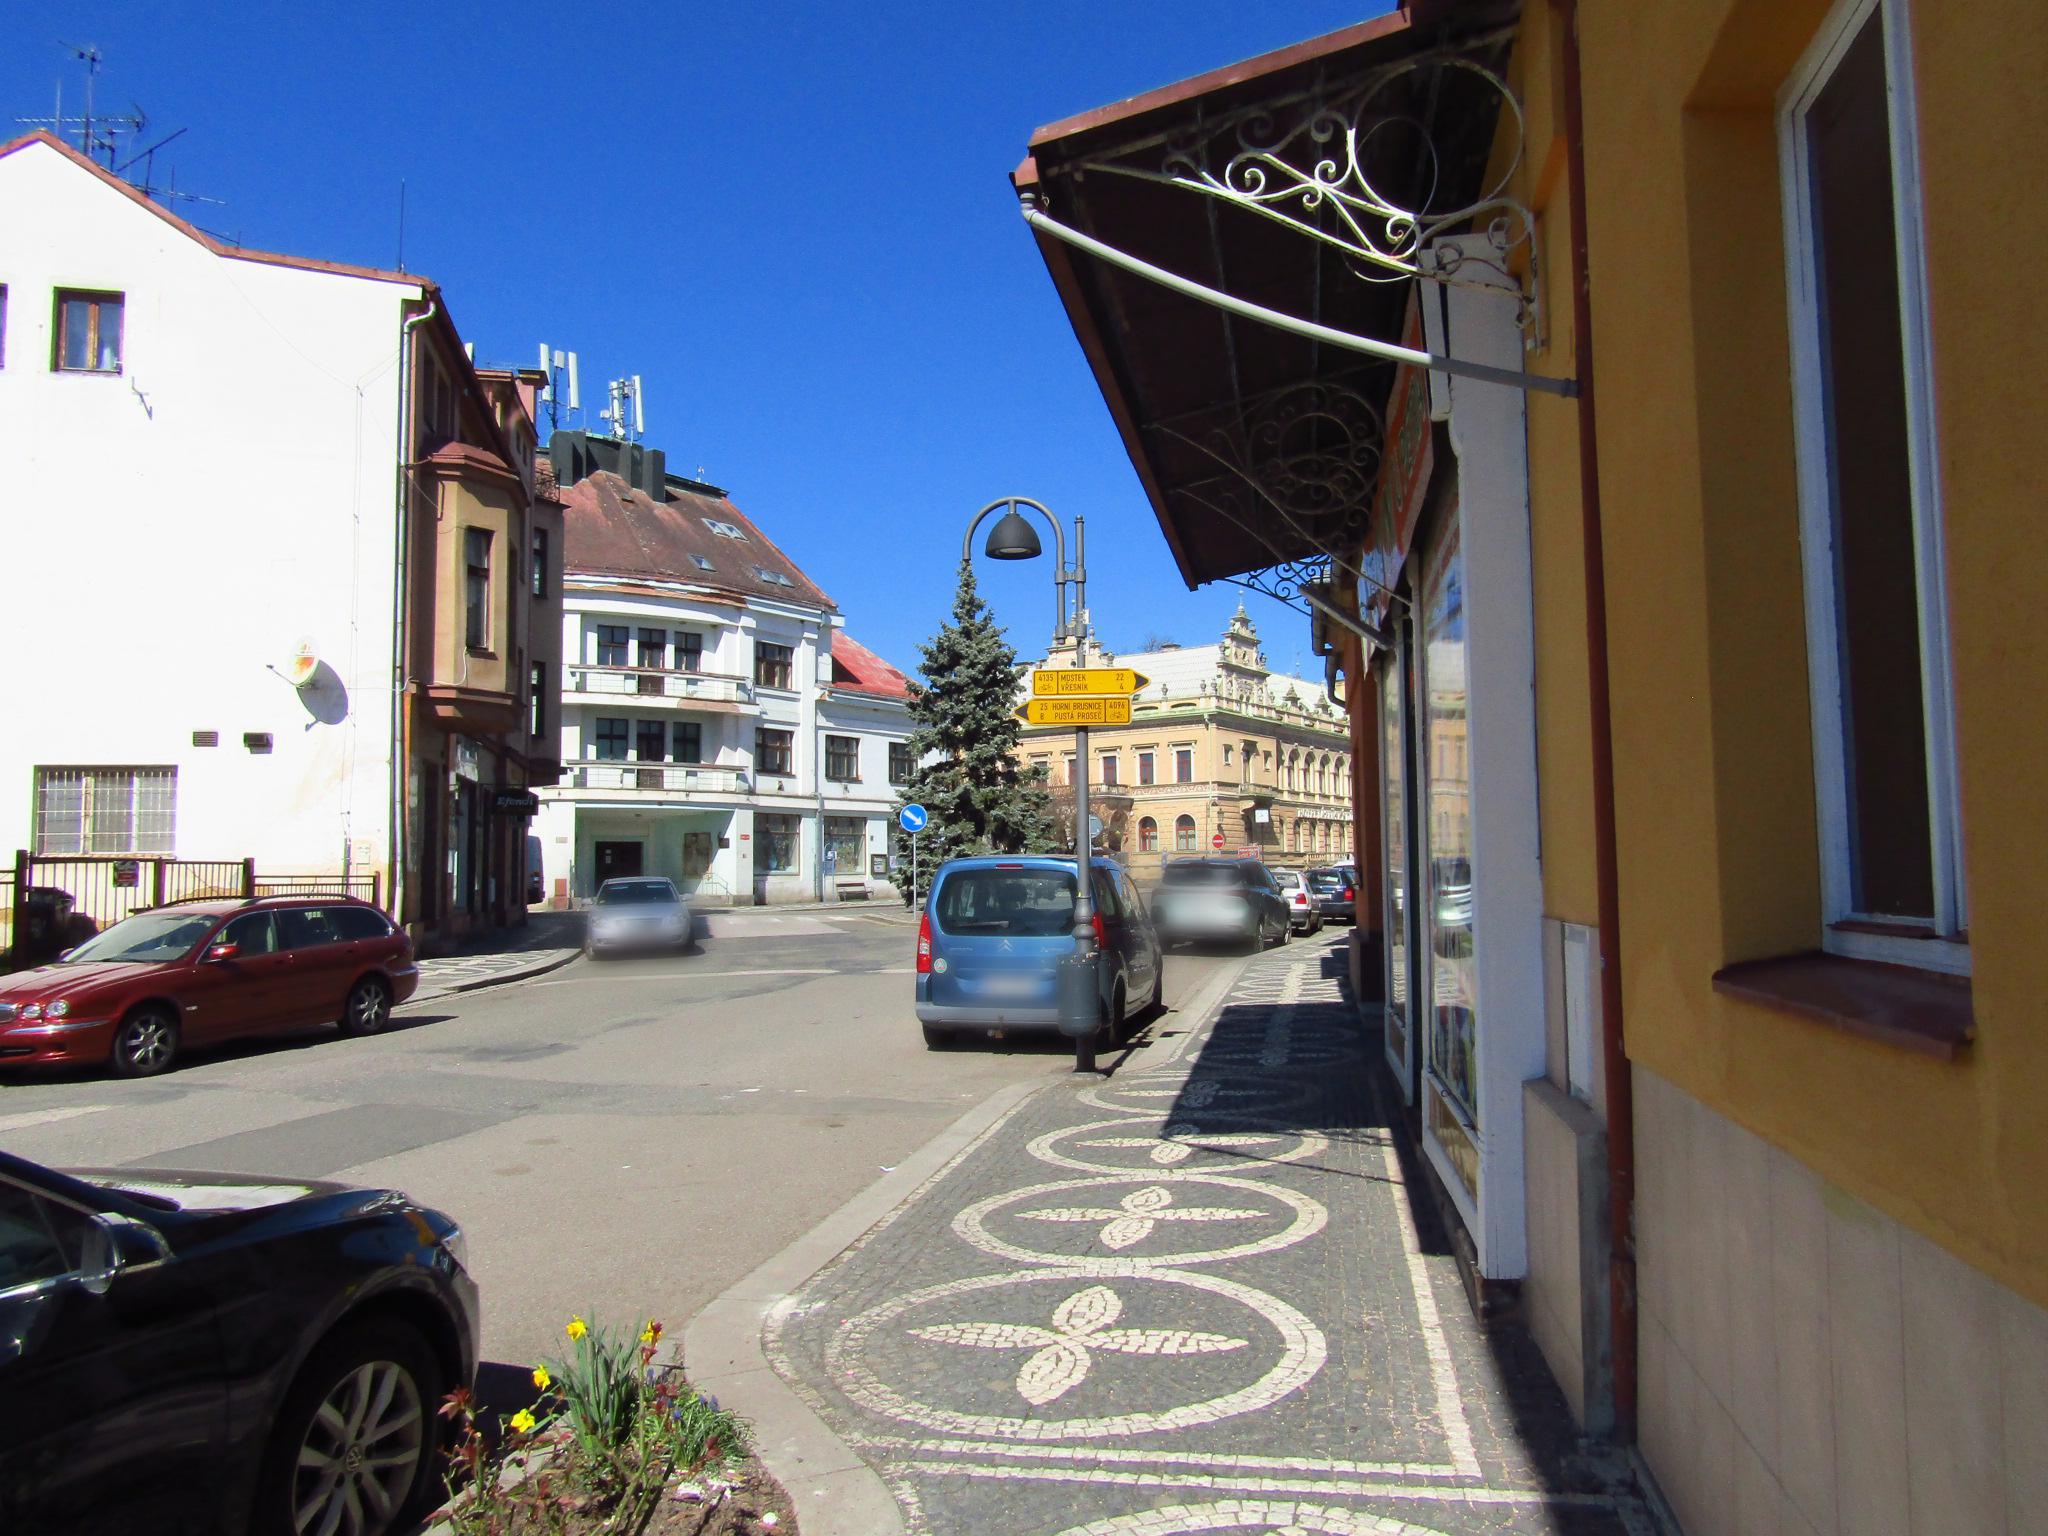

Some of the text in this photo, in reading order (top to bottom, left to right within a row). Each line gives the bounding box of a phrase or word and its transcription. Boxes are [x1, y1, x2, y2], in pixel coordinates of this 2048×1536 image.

[1061, 673, 1124, 682] MOSTEK 22
[1040, 702, 1048, 711] 25
[1072, 702, 1102, 711] BRUSNICE
[1108, 700, 1125, 710] 4096
